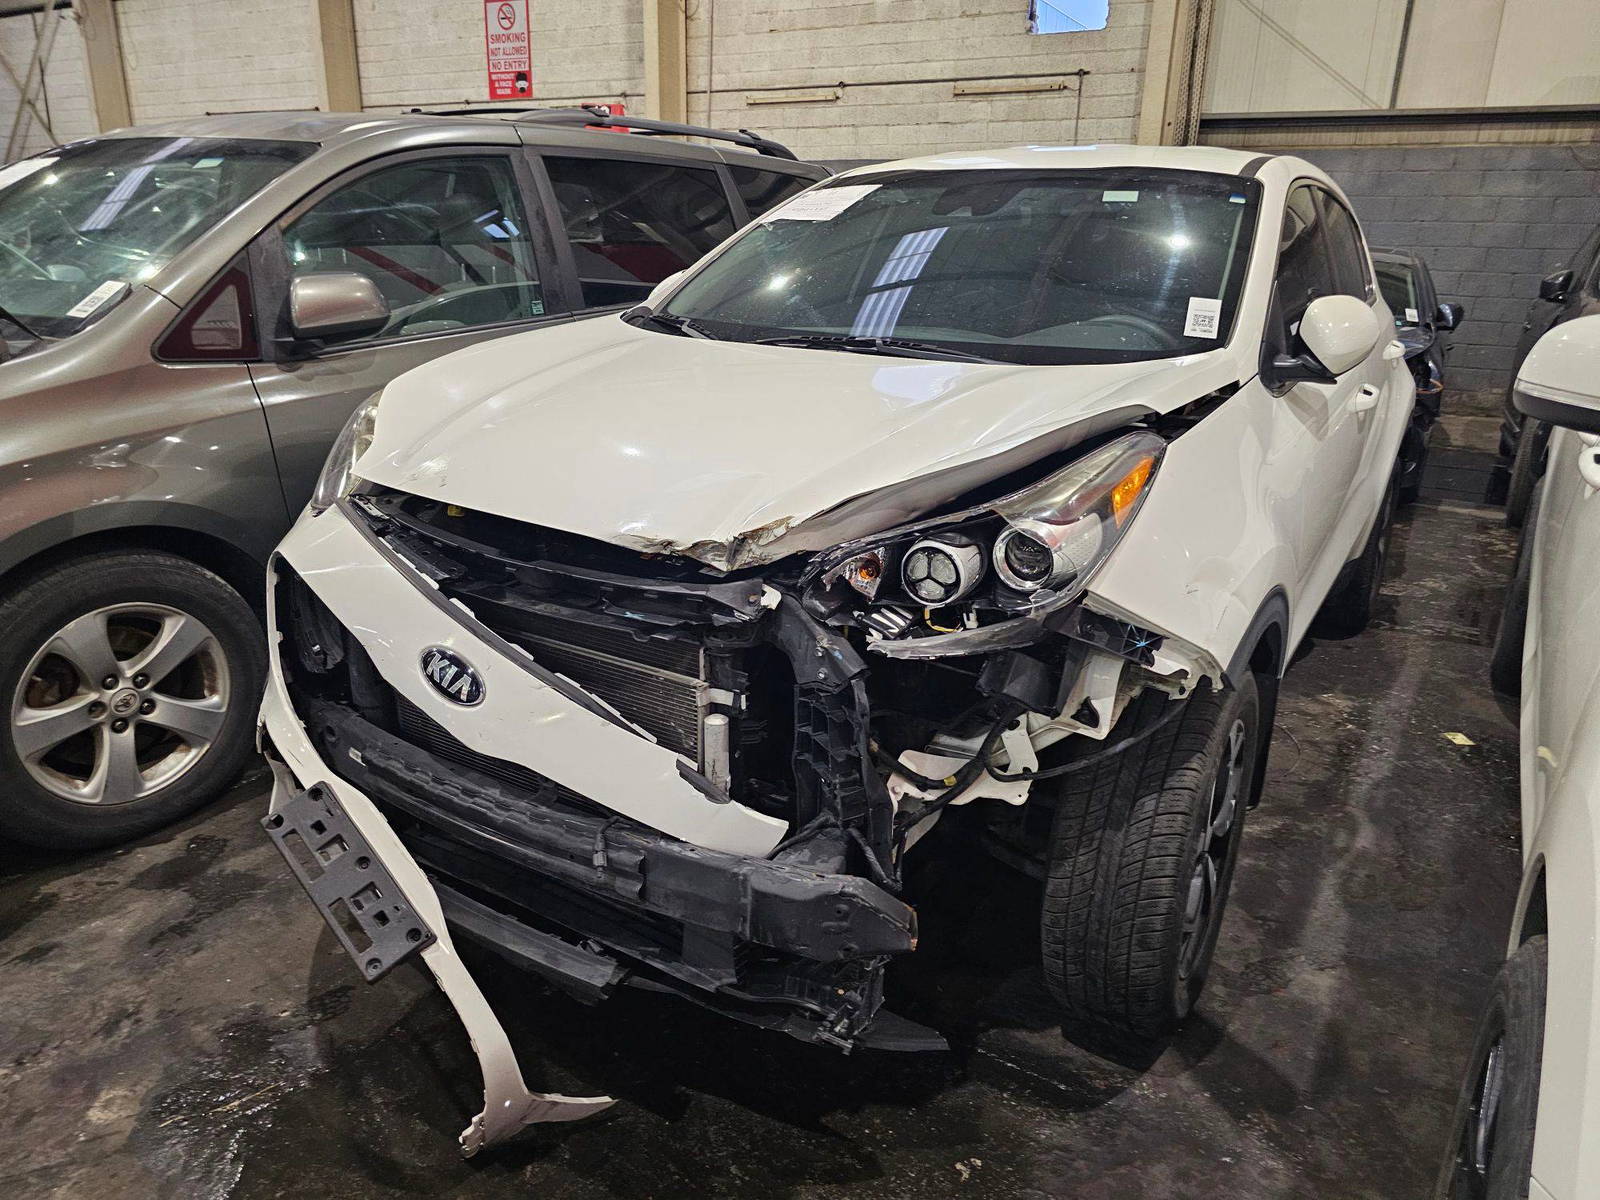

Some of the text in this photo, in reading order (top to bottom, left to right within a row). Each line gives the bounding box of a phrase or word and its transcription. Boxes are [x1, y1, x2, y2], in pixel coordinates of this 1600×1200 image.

[491, 32, 526, 44] SMOKING
[490, 46, 527, 56] NOT ALLOWED
[491, 60, 527, 71] NO ENTRY
[426, 651, 472, 702] KIA
